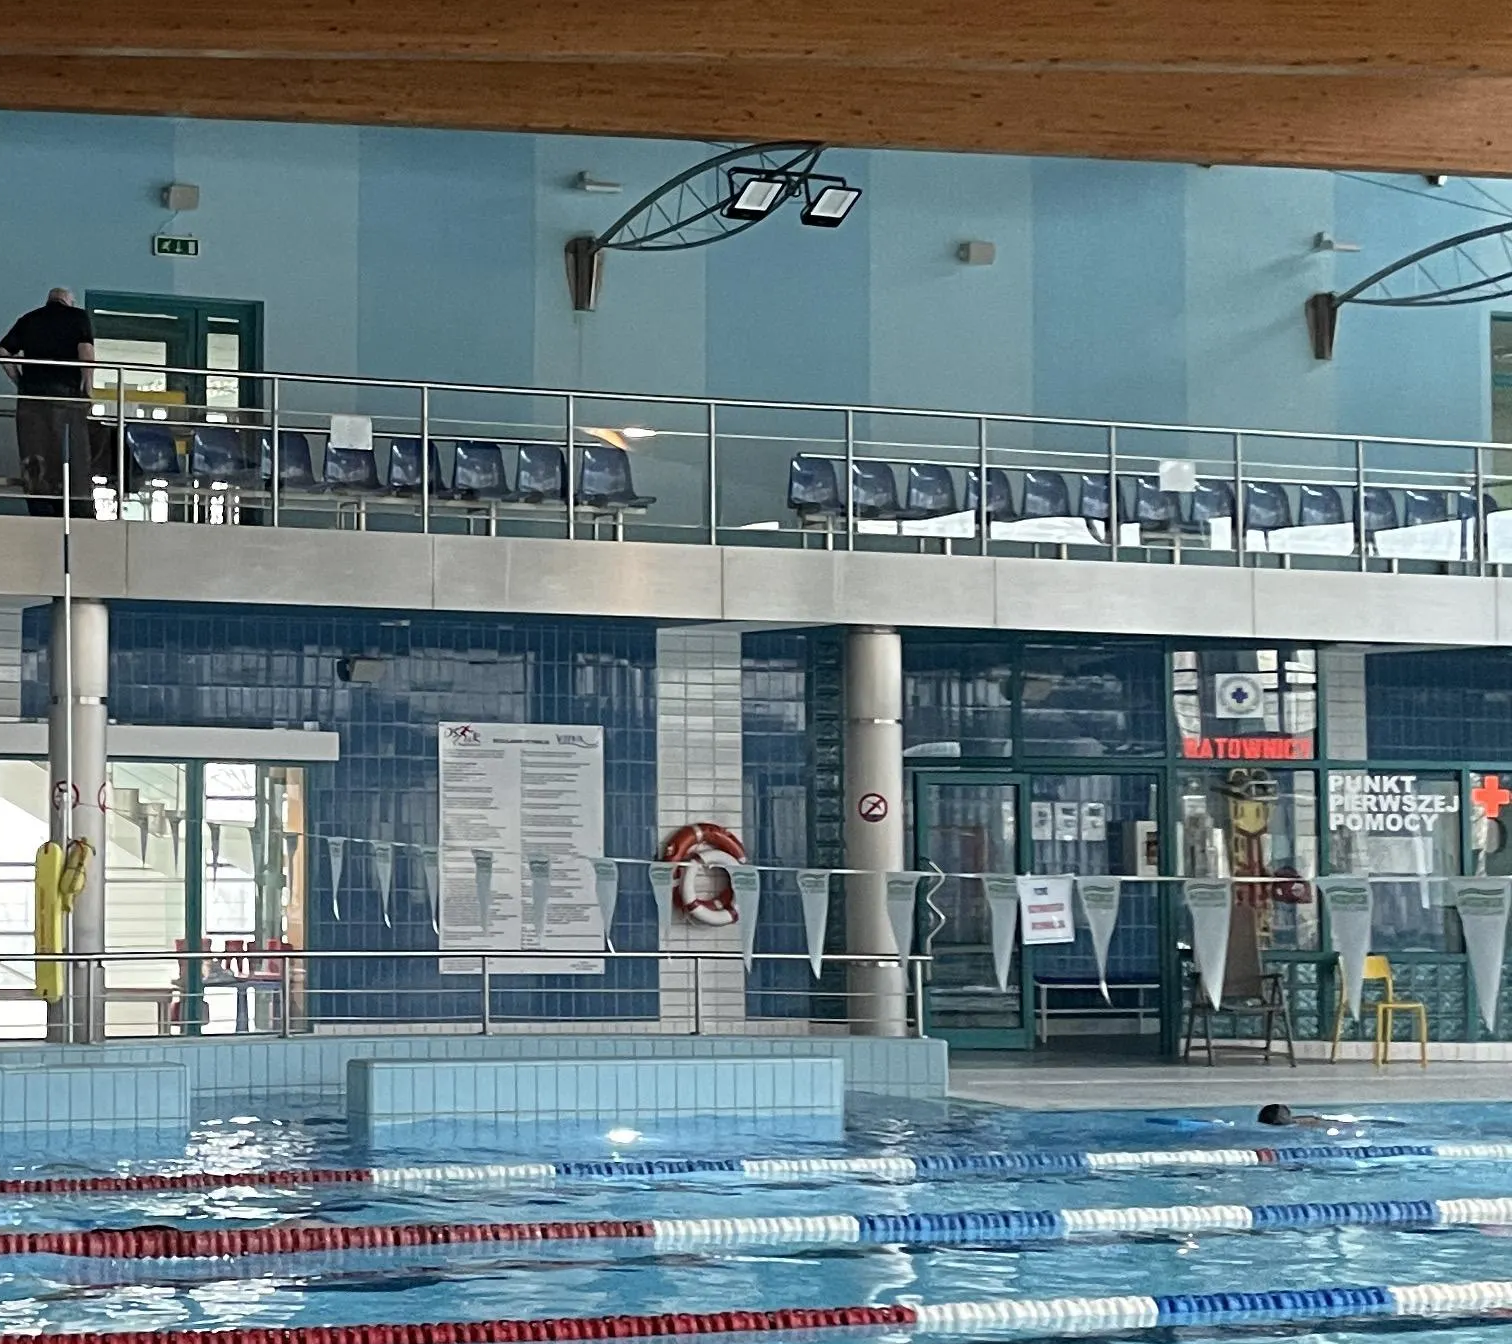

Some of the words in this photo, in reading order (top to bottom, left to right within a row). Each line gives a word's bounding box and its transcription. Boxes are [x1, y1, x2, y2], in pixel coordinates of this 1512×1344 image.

[1328, 775, 1417, 793] PUNKT
[1328, 794, 1460, 813] PIERWSZEJ
[1328, 813, 1438, 832] POMOCY
